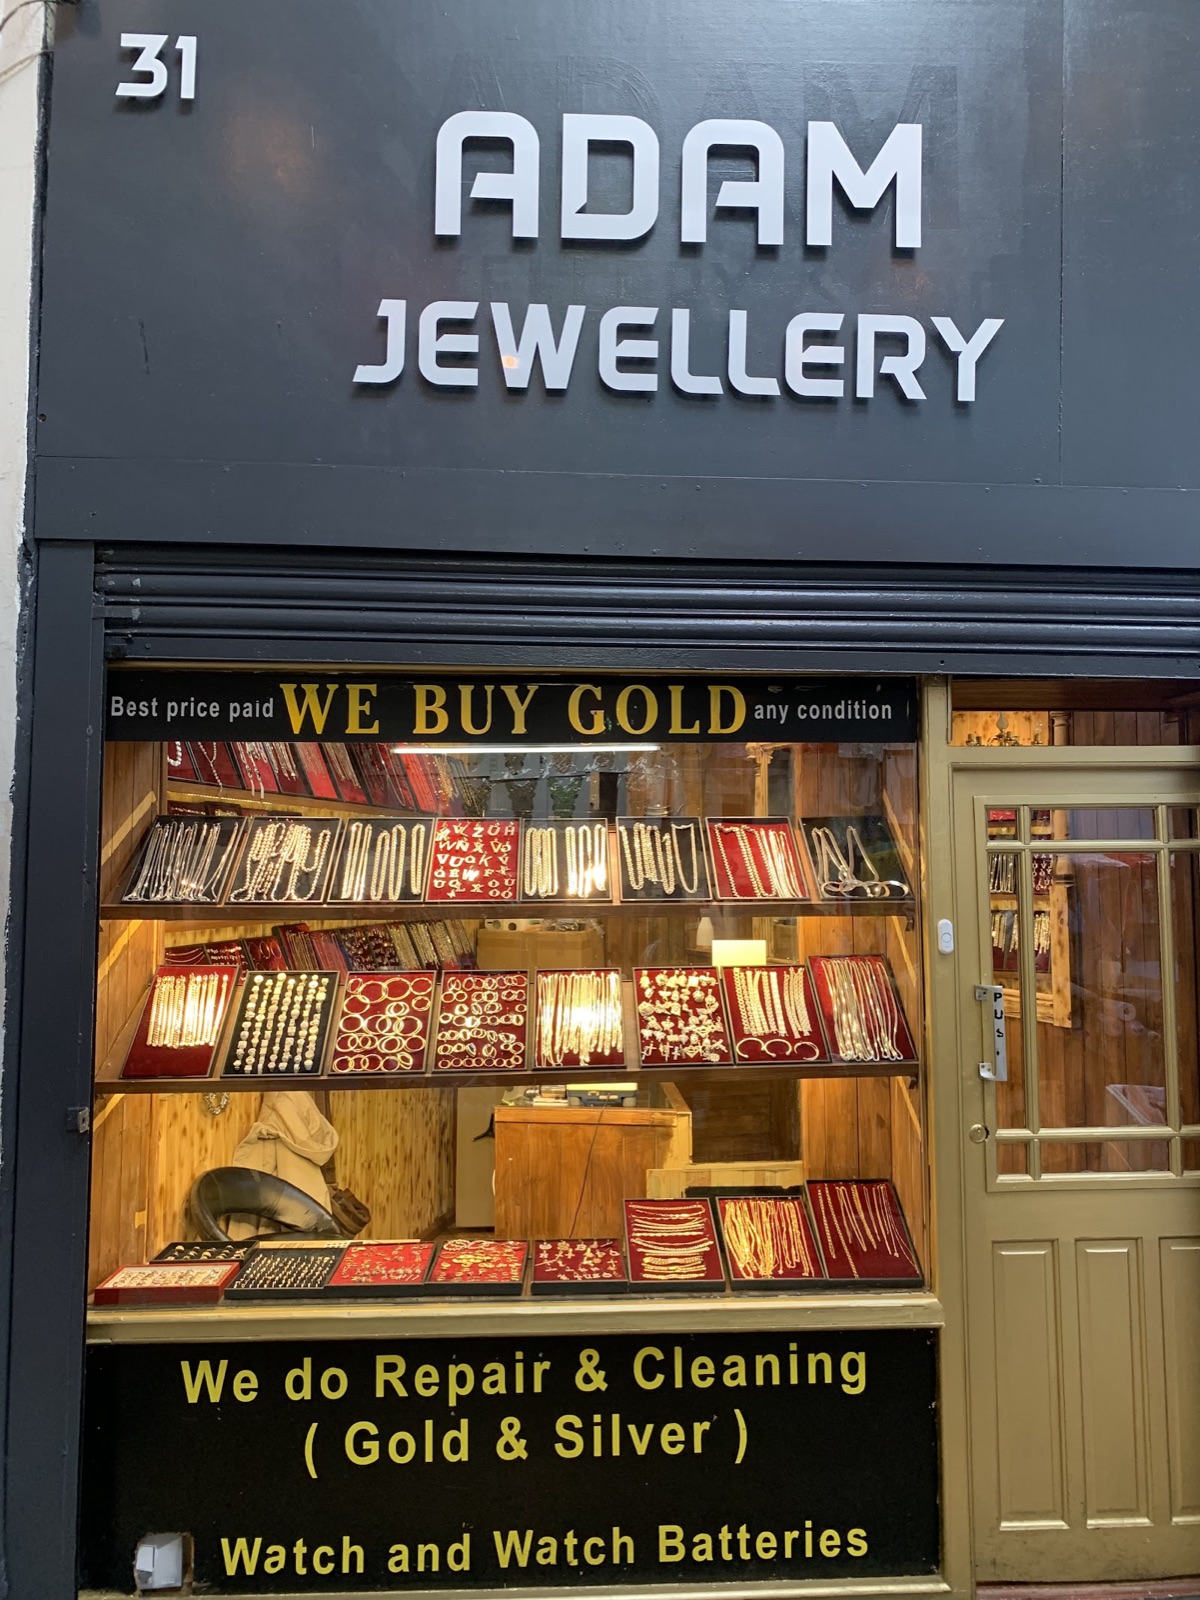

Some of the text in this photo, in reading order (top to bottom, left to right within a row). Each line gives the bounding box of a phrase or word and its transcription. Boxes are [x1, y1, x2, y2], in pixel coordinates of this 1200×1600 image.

[116, 33, 196, 98] 31
[435, 111, 922, 248] ADAM
[353, 299, 1004, 401] JEWELLERY
[112, 684, 891, 734] Best price paid WE BUY GOLD any condition
[993, 992, 1004, 1056] PUS
[182, 1343, 865, 1406] We do Repair & Cleaning
[345, 1419, 468, 1464] Gold
[496, 1417, 528, 1460] &
[555, 1414, 710, 1458] Silver
[222, 1521, 867, 1575] Watch and Watch Batteries
